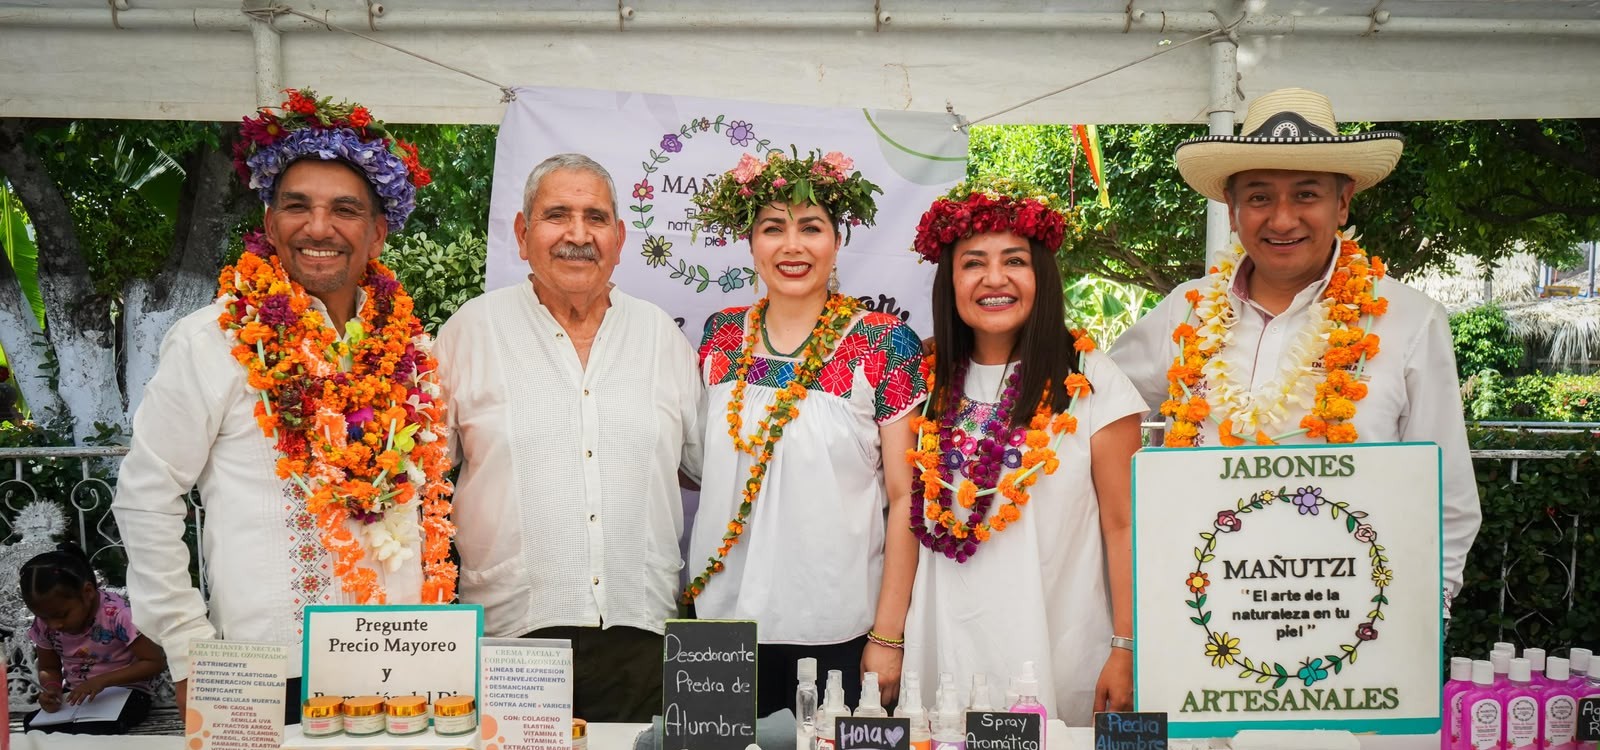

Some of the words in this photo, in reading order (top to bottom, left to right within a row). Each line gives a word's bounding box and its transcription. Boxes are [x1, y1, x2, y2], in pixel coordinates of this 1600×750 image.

[1219, 455, 1356, 479] JABONES
[1223, 555, 1357, 580] MAÑUTZI
[1253, 590, 1268, 602] El
[1271, 590, 1301, 602] arte
[1304, 589, 1323, 601] de
[1326, 589, 1340, 601] la
[1232, 608, 1311, 621] naturaleza
[1313, 609, 1332, 620] en
[1335, 608, 1350, 620] tu
[355, 618, 428, 635] Pregunte
[1276, 624, 1304, 641] piel
[329, 638, 379, 652] Precio
[384, 638, 457, 656] Mayoreo
[664, 633, 755, 662] Desodorante
[196, 678, 252, 686] REGENERACION
[382, 666, 392, 682] y
[676, 670, 725, 693] Piedra
[731, 676, 751, 693] de
[1180, 688, 1400, 713] ARTESANALES
[665, 702, 754, 737] Alumbre
[981, 714, 1027, 733] Spray
[1107, 713, 1160, 734] Piedra
[966, 732, 1039, 750] Aromático
